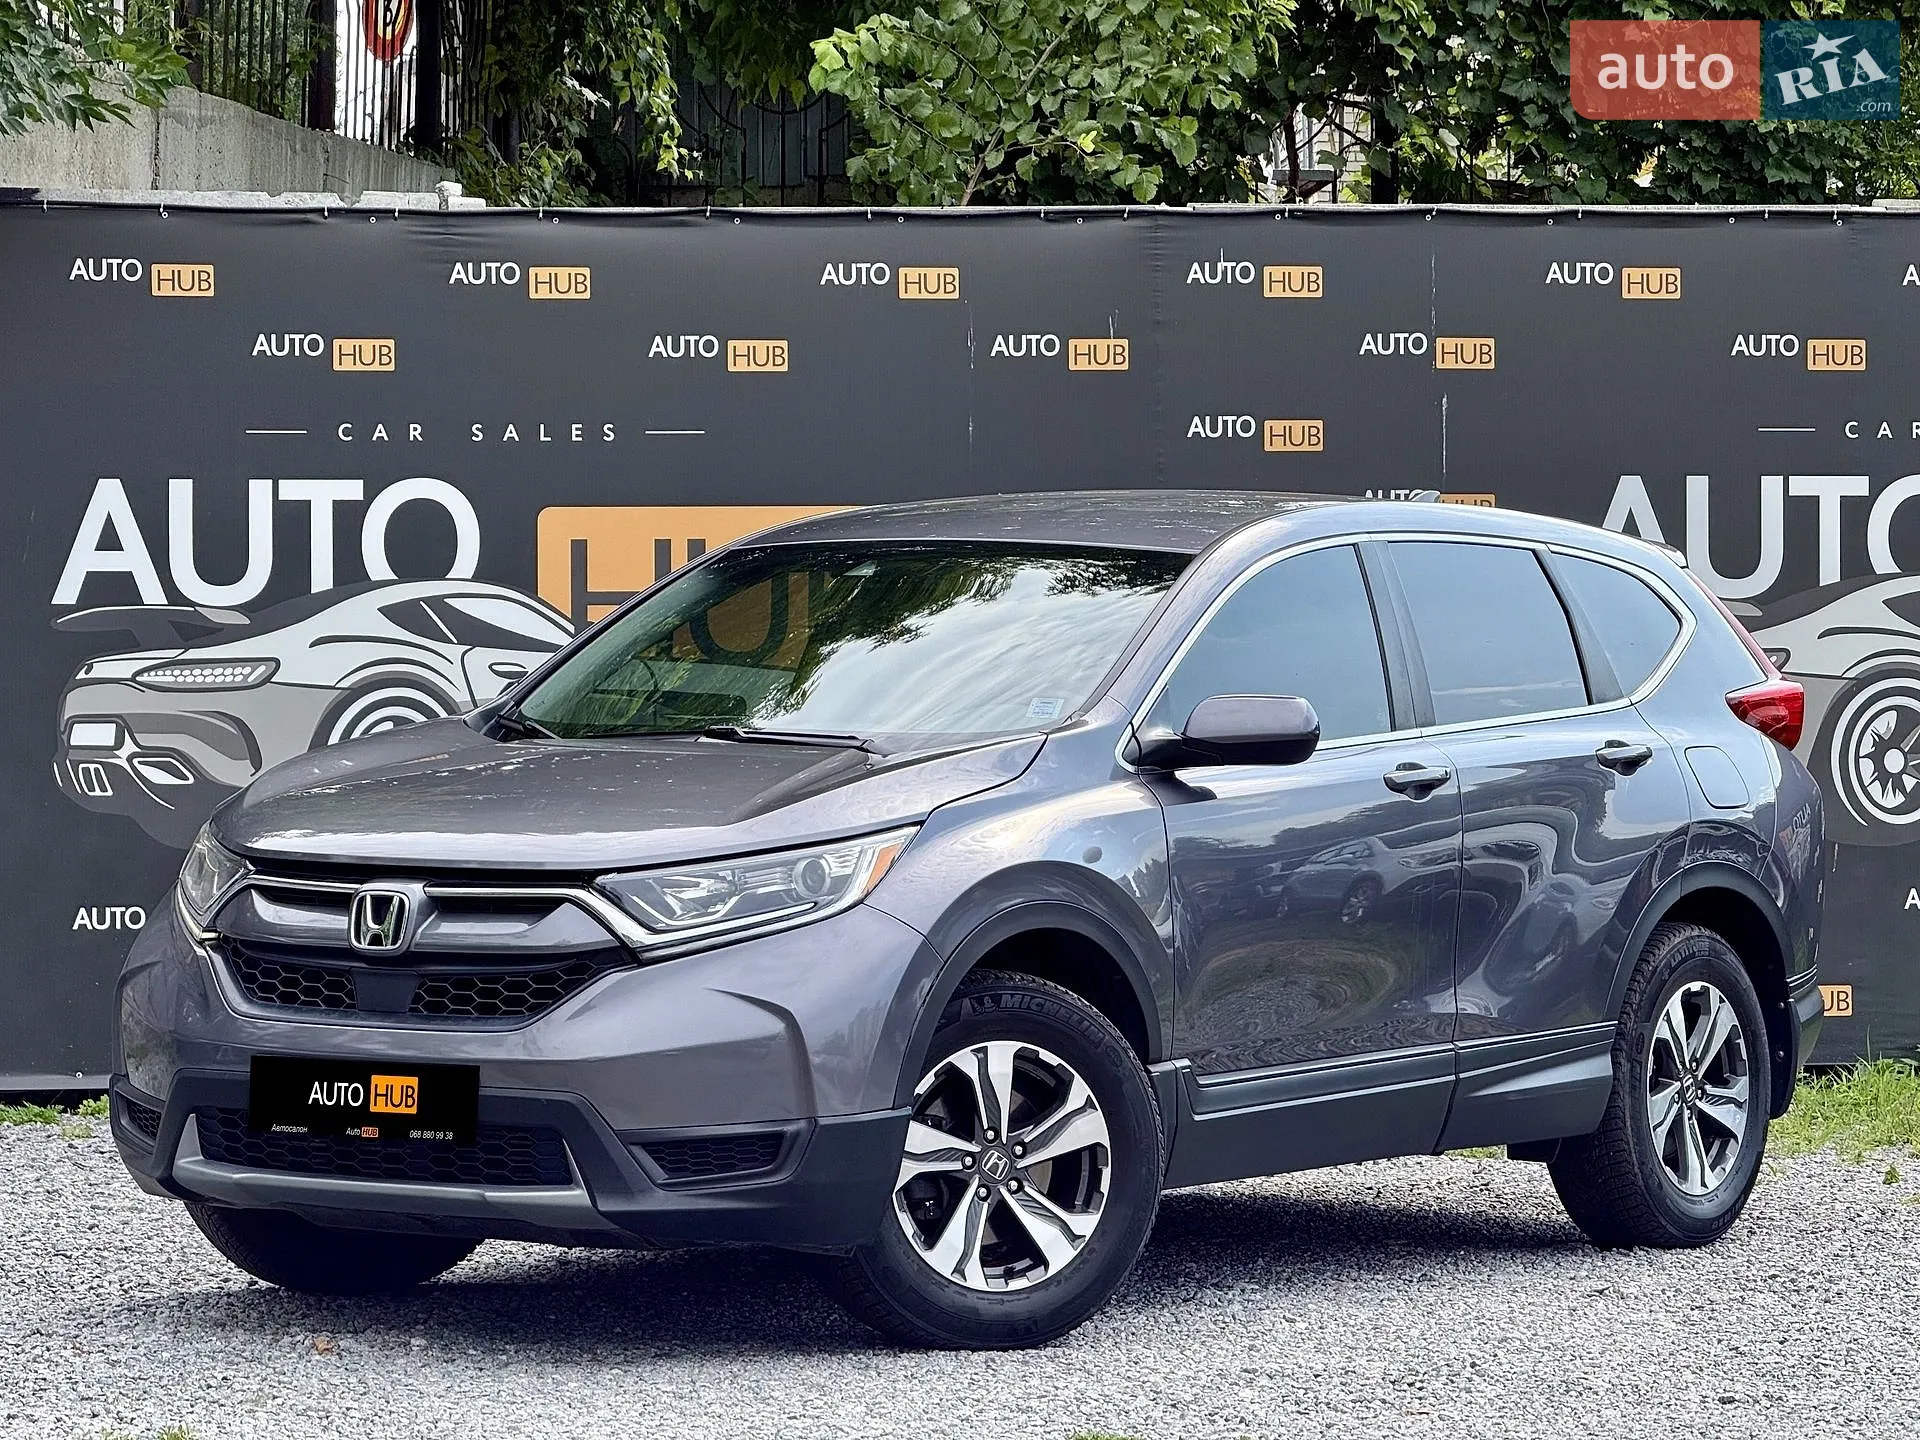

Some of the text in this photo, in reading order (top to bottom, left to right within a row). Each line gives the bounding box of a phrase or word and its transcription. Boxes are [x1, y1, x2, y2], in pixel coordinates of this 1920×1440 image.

[68, 257, 212, 292] AUTO HUB
[448, 261, 588, 295] AUTO HUB
[819, 262, 957, 295] AUTO HUB
[1185, 260, 1320, 293] AUTO HUB
[1544, 261, 1679, 295] AUTO HUB
[251, 333, 393, 367] AUTO HUB
[647, 334, 786, 367] AUTO HUB
[990, 333, 1127, 366] AUTO HUB
[1358, 332, 1493, 365] AUTO HUB
[1730, 334, 1864, 366] AUTO HUB
[337, 423, 616, 442] CAR SALES
[1186, 415, 1321, 447] AUTO HUB
[51, 477, 481, 604] AUTO
[71, 906, 147, 931] AUTO
[1000, 994, 1106, 1050] MICHELIN
[308, 1081, 416, 1109] AUTO HUB
[345, 1127, 378, 1137] Auto HUB
